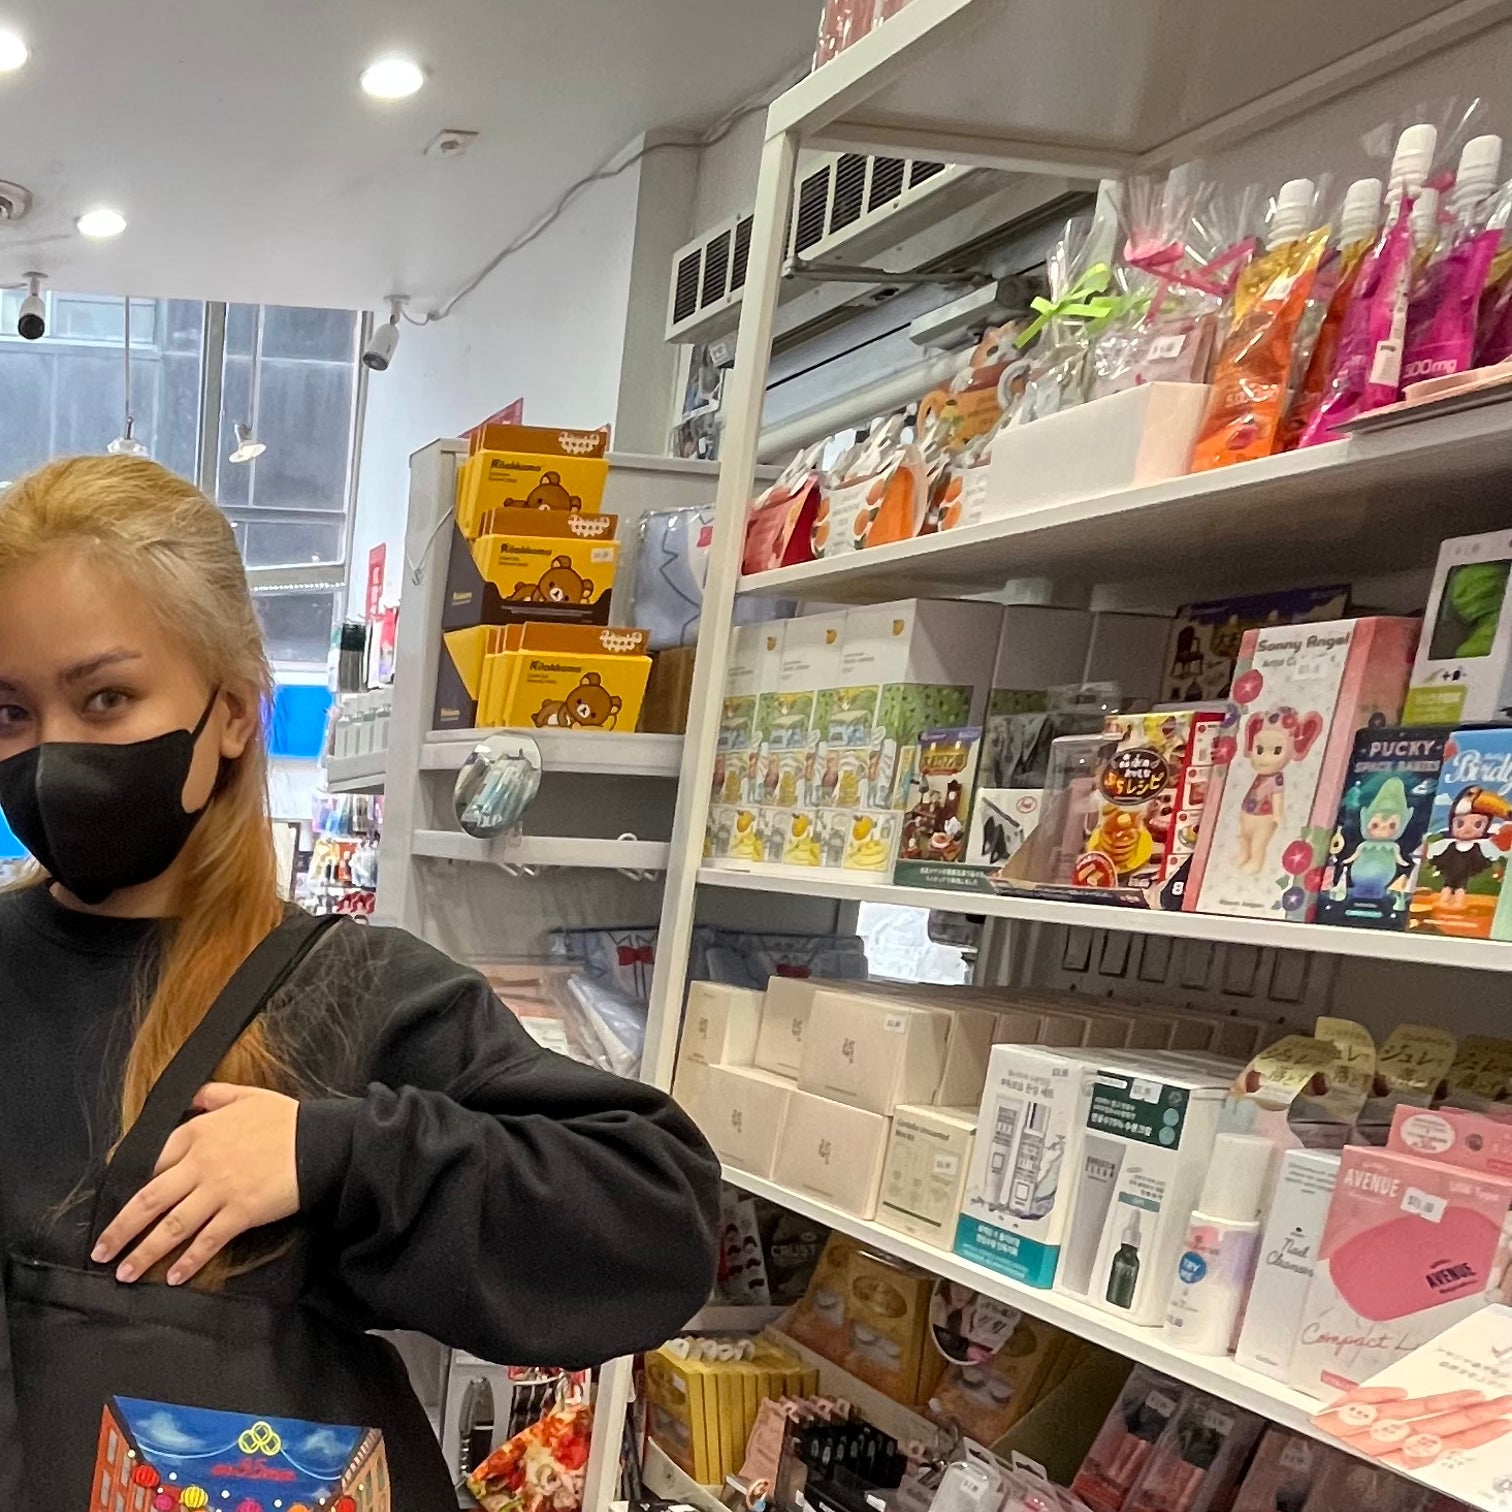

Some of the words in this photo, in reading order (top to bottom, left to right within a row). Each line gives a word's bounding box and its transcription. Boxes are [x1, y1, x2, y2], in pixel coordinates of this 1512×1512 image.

[1257, 634, 1303, 653] Sonny
[1306, 631, 1351, 650] Angel
[1369, 740, 1435, 758] PUCKY
[1344, 1168, 1401, 1198] AVENUE
[1426, 1262, 1477, 1289] AVENUE
[1299, 1322, 1388, 1356] Compact
